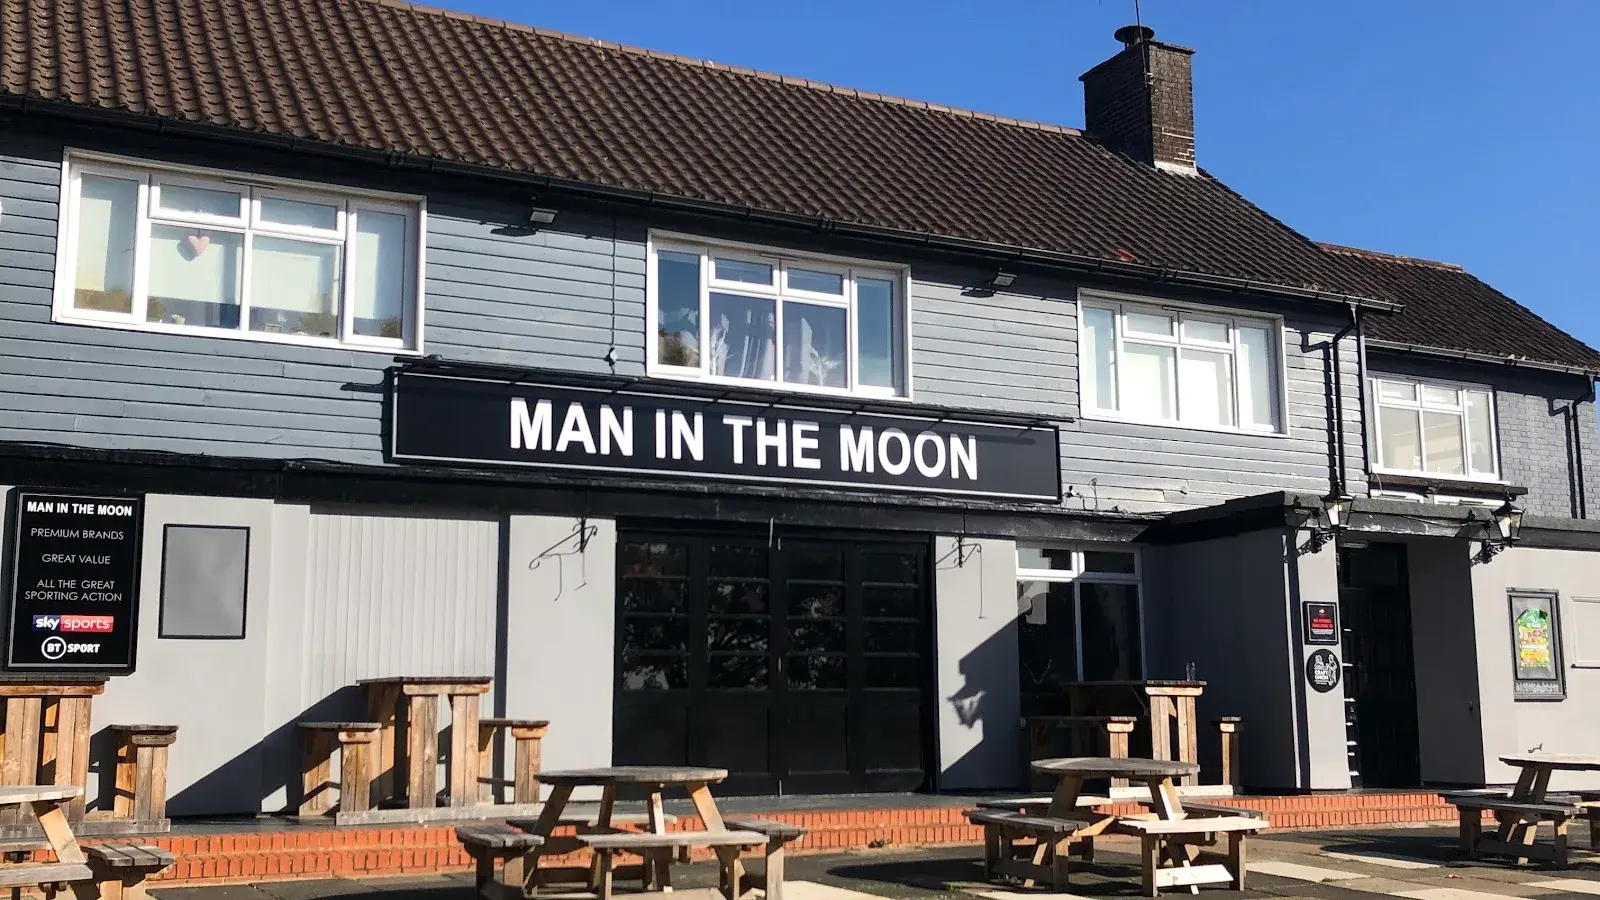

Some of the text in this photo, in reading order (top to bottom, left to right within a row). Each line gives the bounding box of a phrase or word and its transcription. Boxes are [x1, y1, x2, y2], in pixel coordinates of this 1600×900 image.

[510, 397, 978, 480] MAN IN THE MOON
[27, 501, 133, 517] MAN IN THE MOON
[30, 527, 124, 541] PREMIUM BRANDS
[41, 553, 111, 565] GREAT VALUE
[36, 579, 115, 590] ALL THE GREAT
[24, 590, 123, 602] SPORTING ACTION
[35, 615, 110, 631] sky sports
[46, 643, 101, 654] BT SPORT
